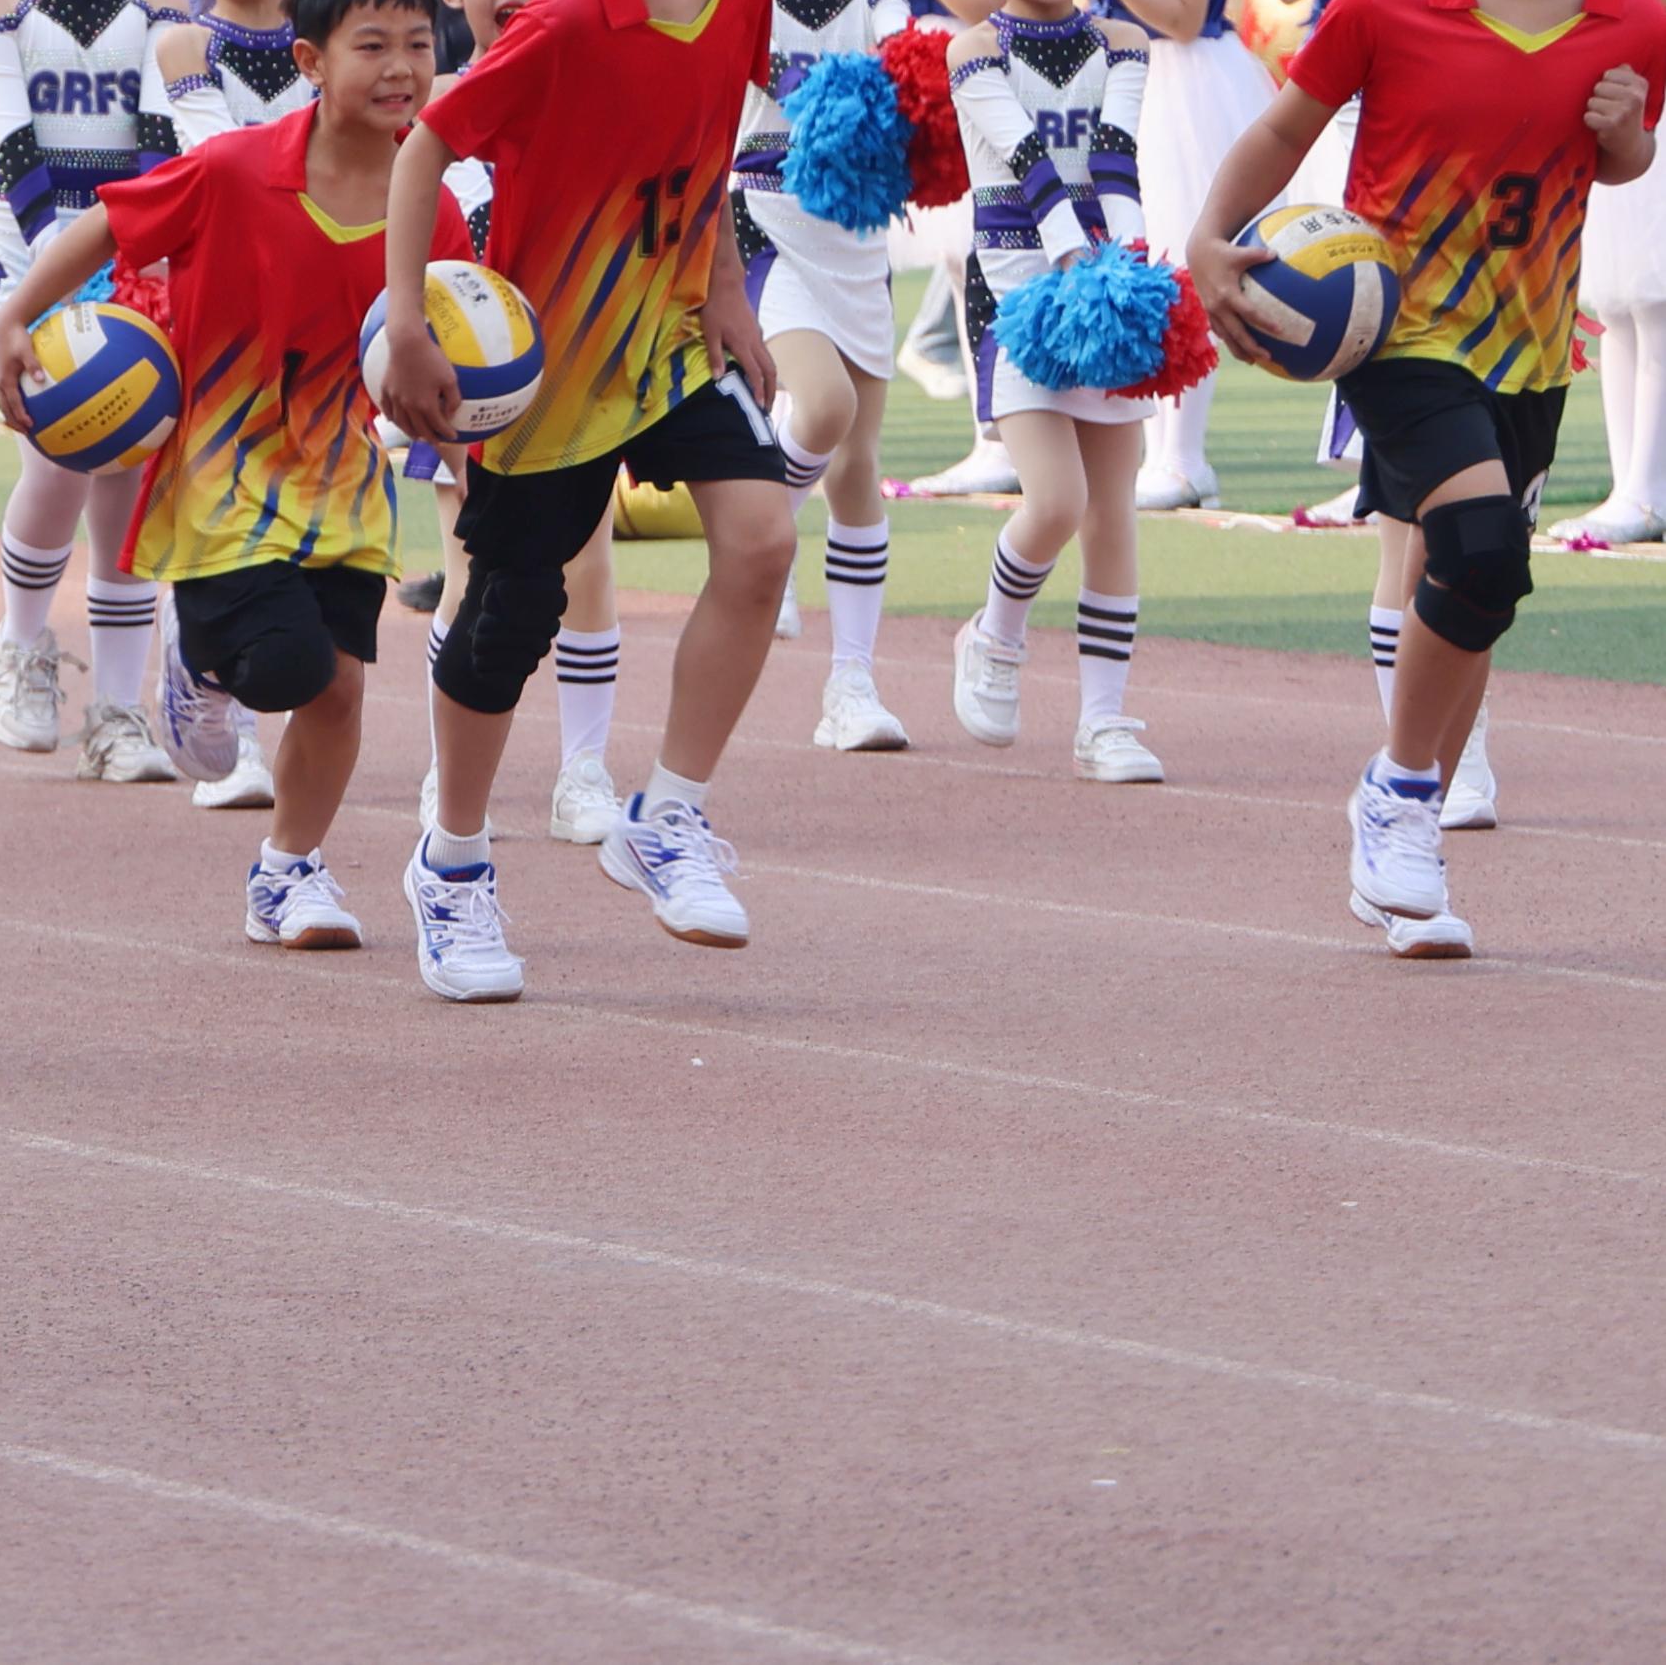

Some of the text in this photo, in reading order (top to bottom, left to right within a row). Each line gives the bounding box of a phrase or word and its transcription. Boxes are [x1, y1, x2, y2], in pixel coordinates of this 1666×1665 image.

[27, 69, 141, 116] GRFS
[1486, 172, 1541, 250] 3
[715, 369, 775, 446] 1
